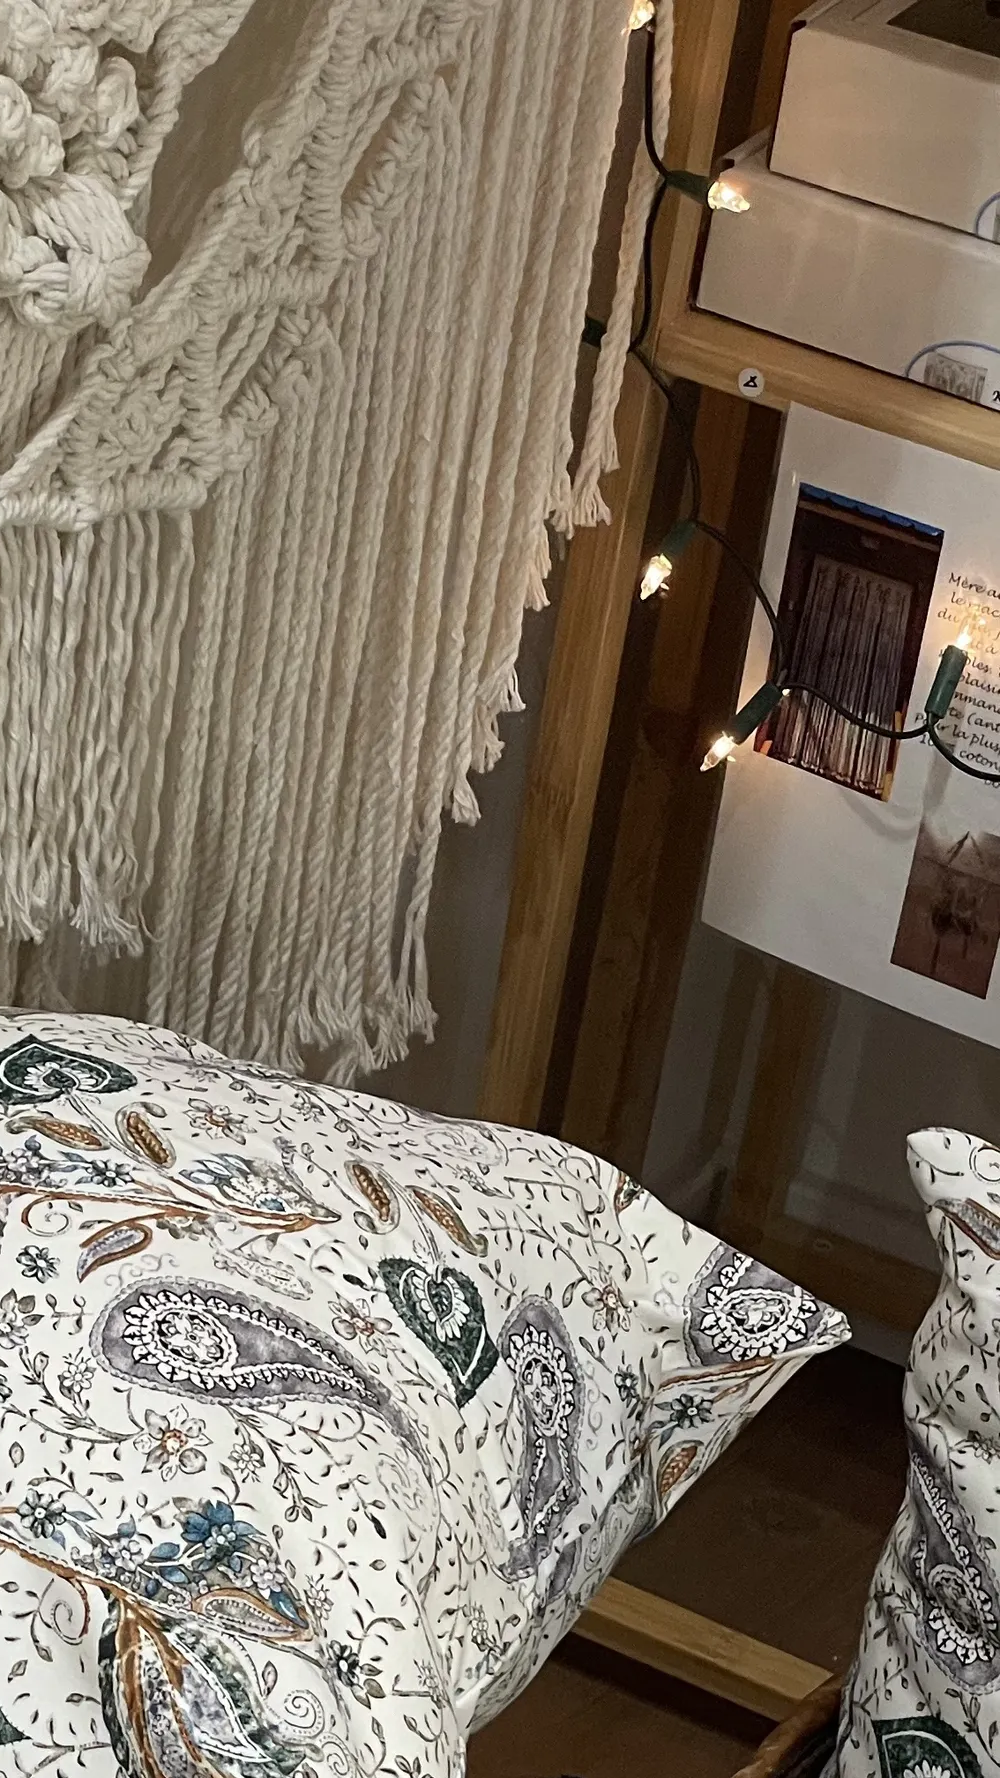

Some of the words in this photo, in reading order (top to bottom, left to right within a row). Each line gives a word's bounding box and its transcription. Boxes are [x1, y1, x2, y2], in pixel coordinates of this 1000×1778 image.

[951, 591, 966, 606] le
[937, 608, 960, 623] du
[952, 724, 969, 740] la
